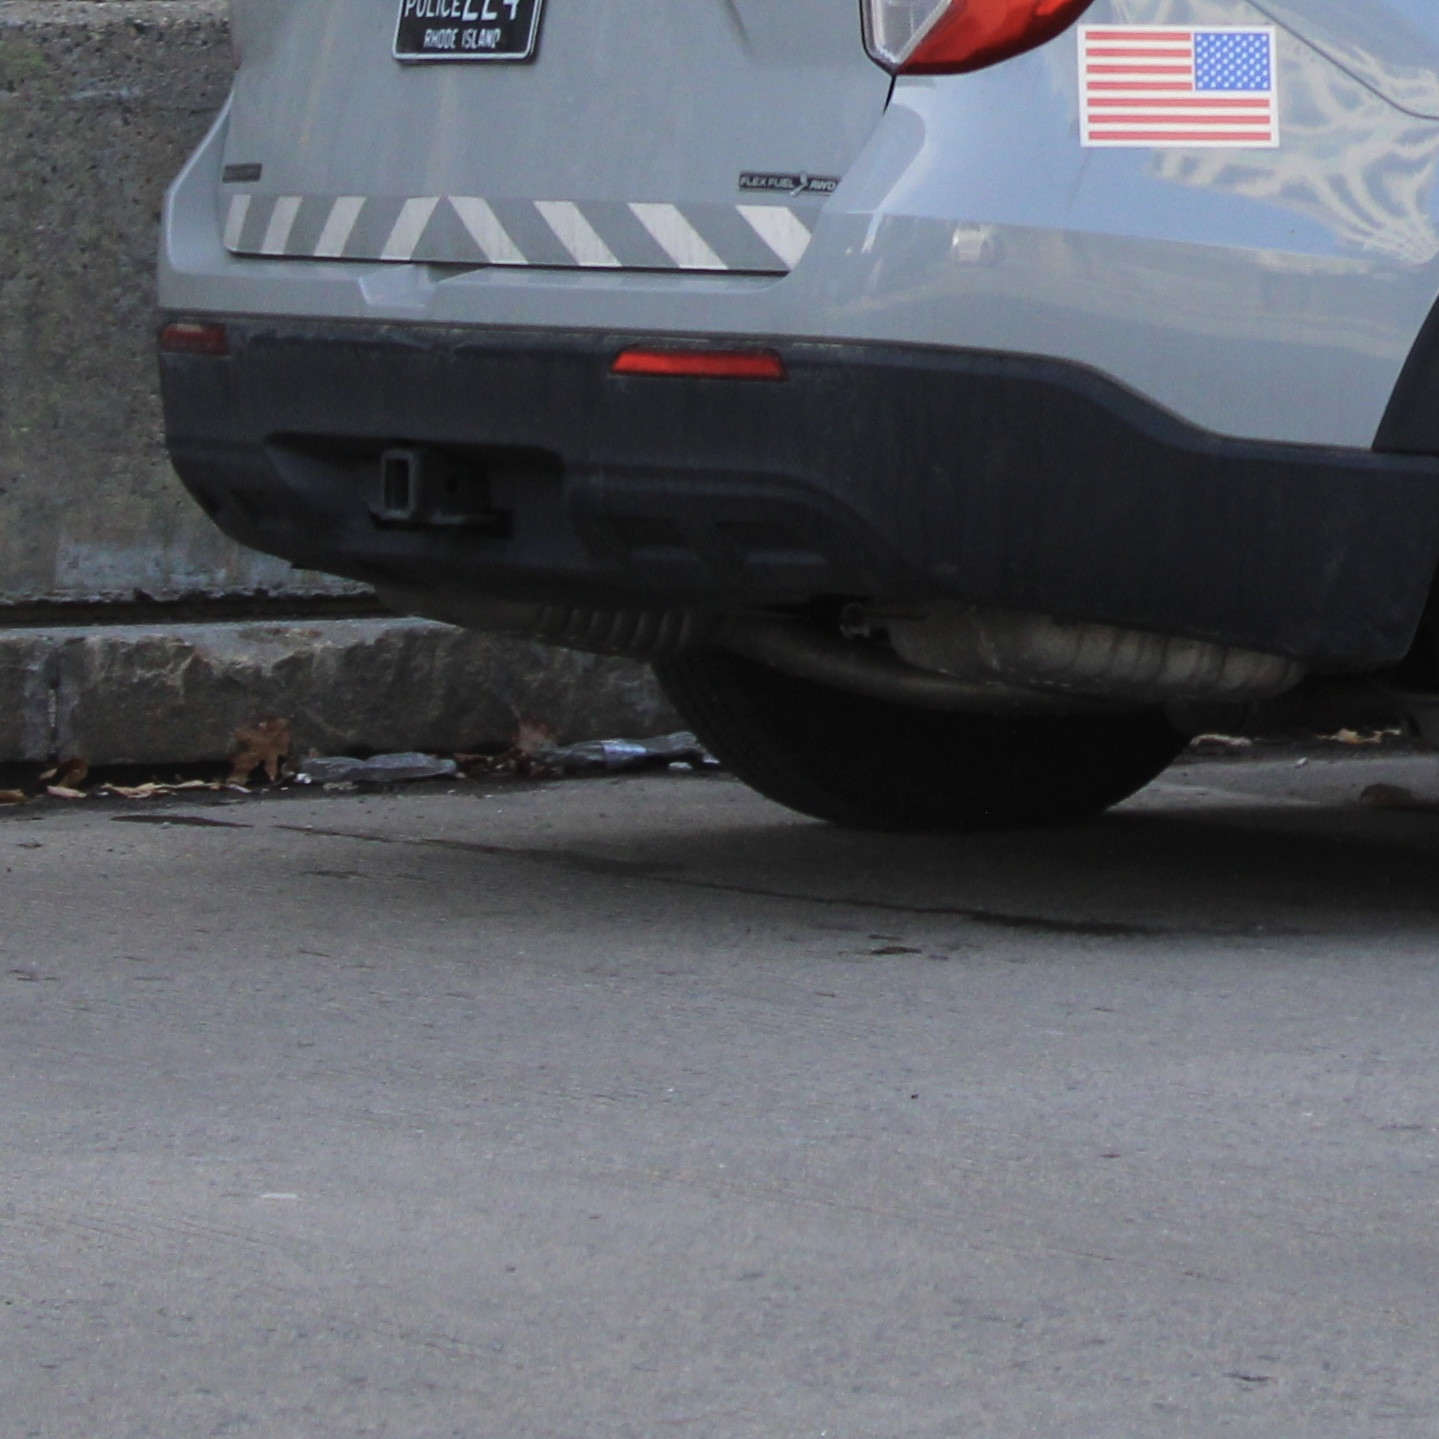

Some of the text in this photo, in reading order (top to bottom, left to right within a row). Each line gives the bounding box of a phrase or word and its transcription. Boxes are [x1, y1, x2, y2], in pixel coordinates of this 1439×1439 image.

[423, 28, 458, 48] RHODE
[740, 175, 836, 191] FLEX FUEL AWD
